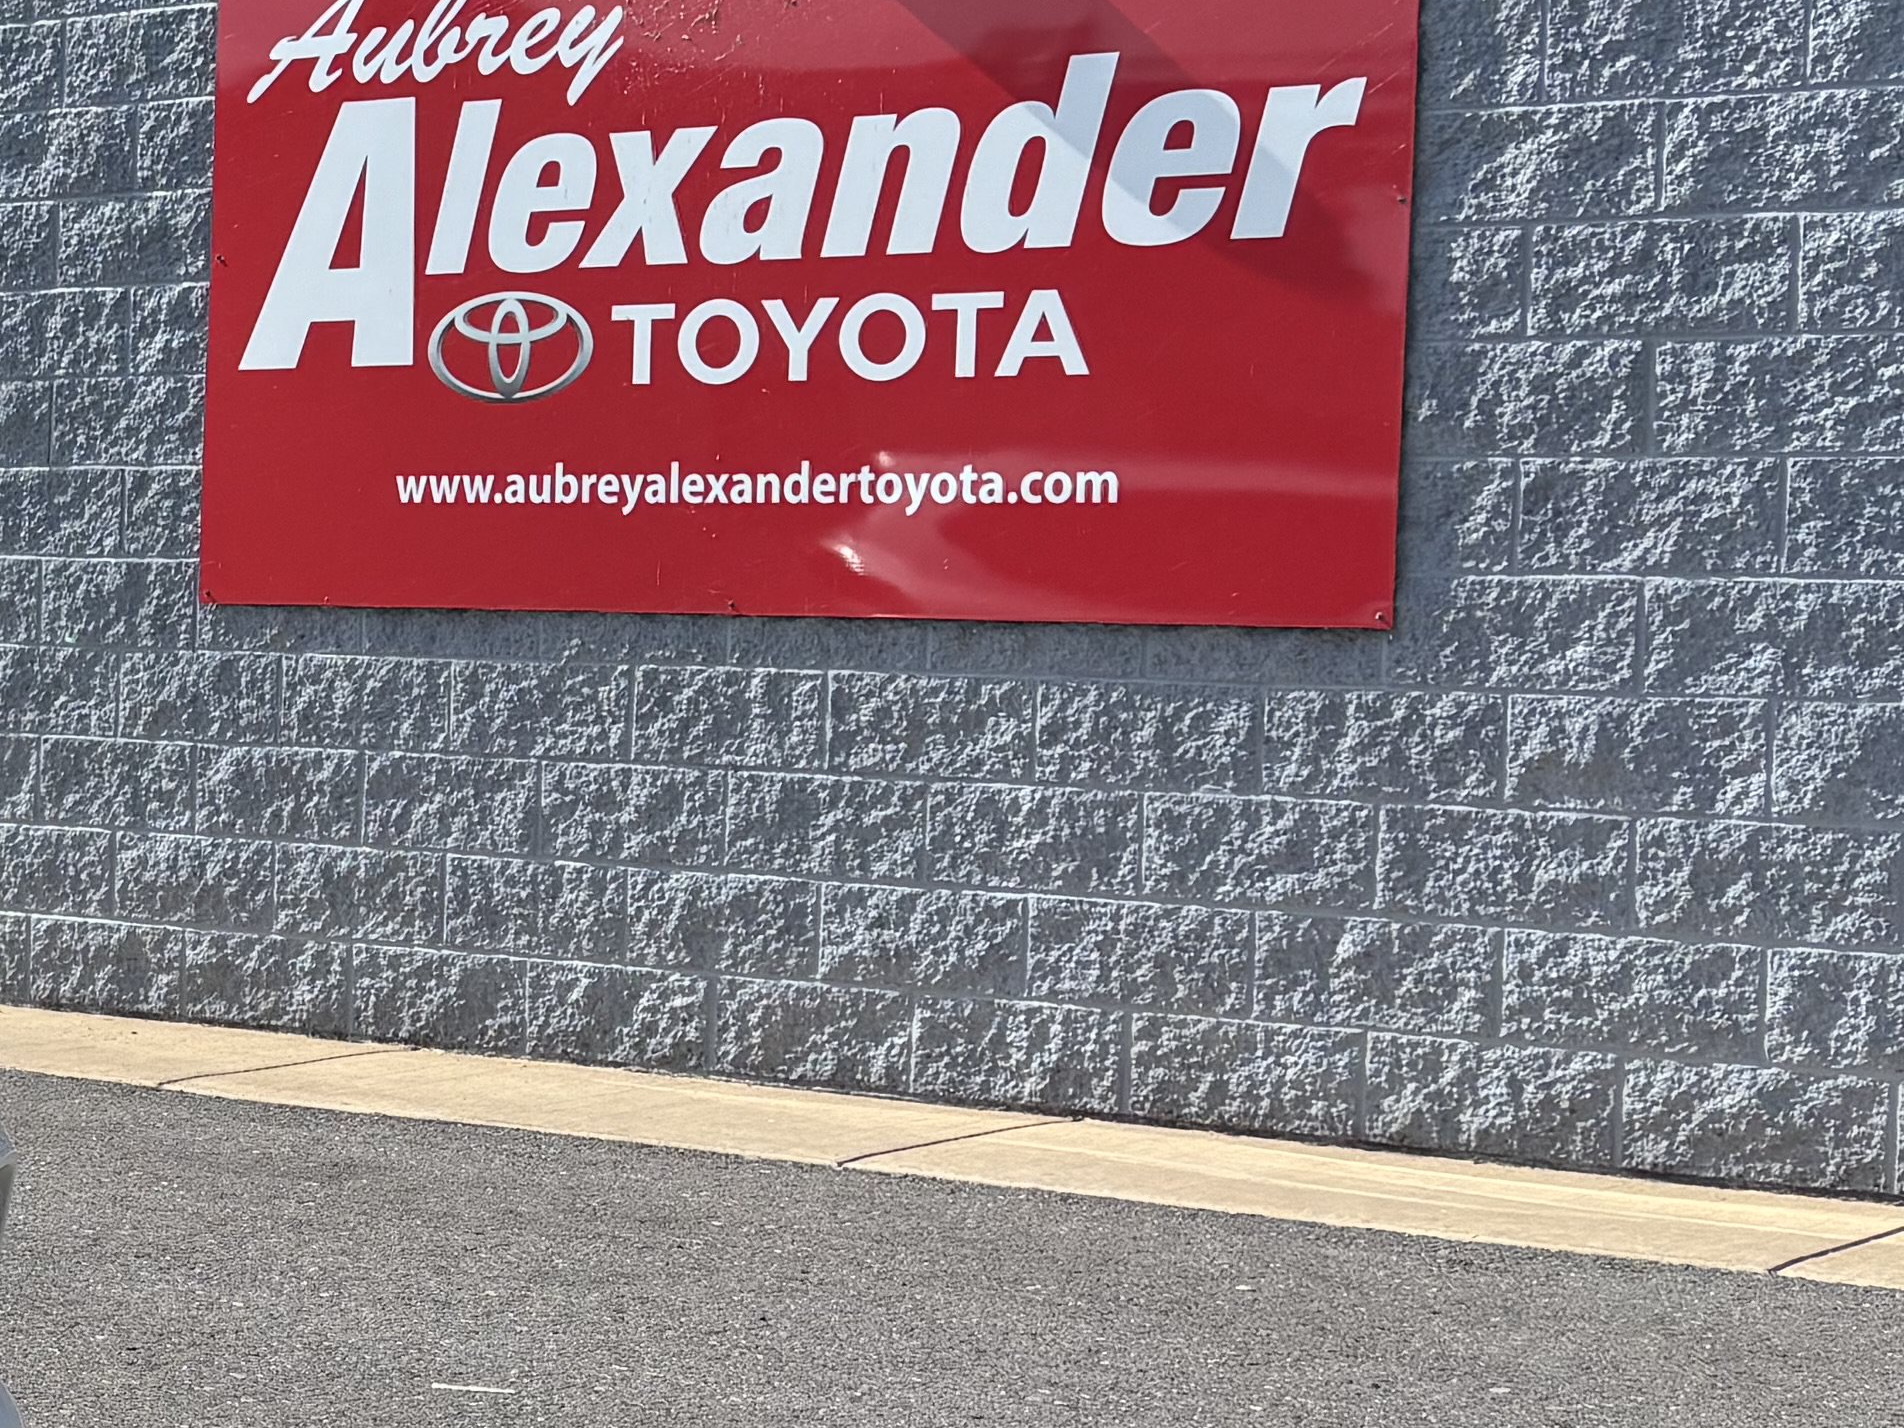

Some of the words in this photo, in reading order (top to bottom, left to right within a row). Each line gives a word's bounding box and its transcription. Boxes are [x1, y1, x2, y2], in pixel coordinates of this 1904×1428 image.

[237, 52, 1368, 371] Alexander
[610, 290, 1090, 385] TOYOTA
[395, 460, 1120, 518] www.aubreyalexandertoyota.com
